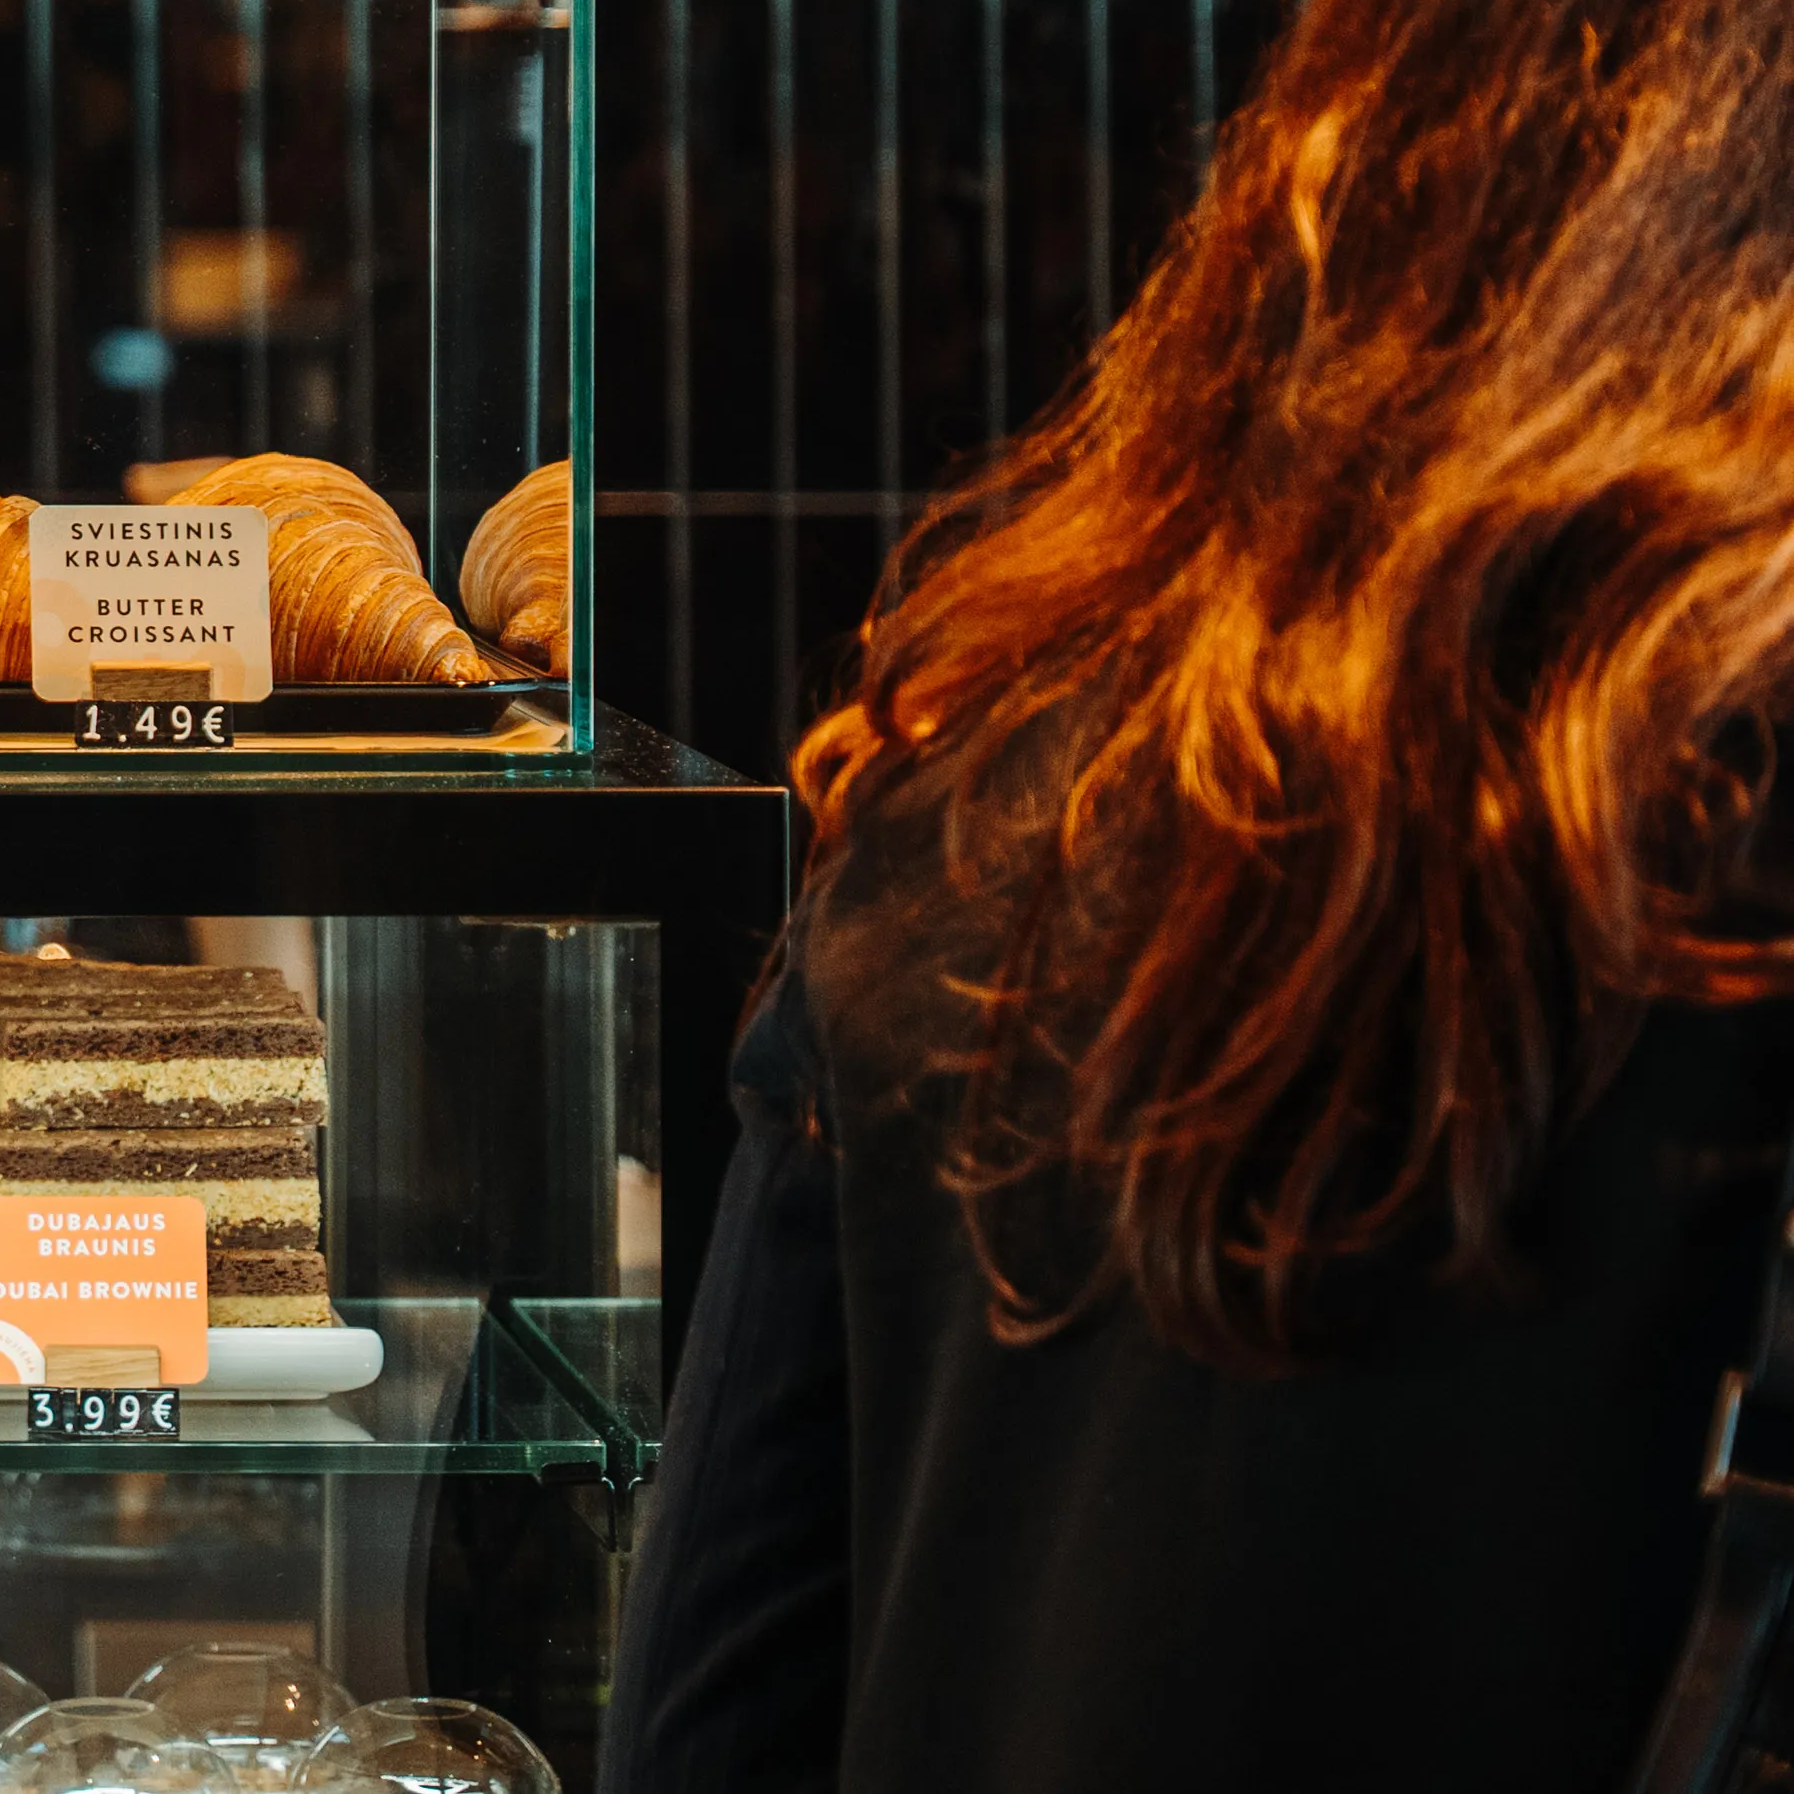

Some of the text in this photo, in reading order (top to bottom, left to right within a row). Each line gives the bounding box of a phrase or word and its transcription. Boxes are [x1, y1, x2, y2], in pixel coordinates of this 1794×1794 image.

[70, 521, 233, 540] SVIESTINIS
[65, 549, 241, 567] KRUASANAS
[97, 599, 204, 616] BUTTER
[68, 625, 236, 643] CROISSANT
[82, 705, 226, 743] 1.49€
[28, 1213, 166, 1232] DUBAJAUS
[38, 1238, 156, 1256] BRAUNIS
[79, 1281, 198, 1299] BROWNIE
[33, 1393, 175, 1431] 3.99€
